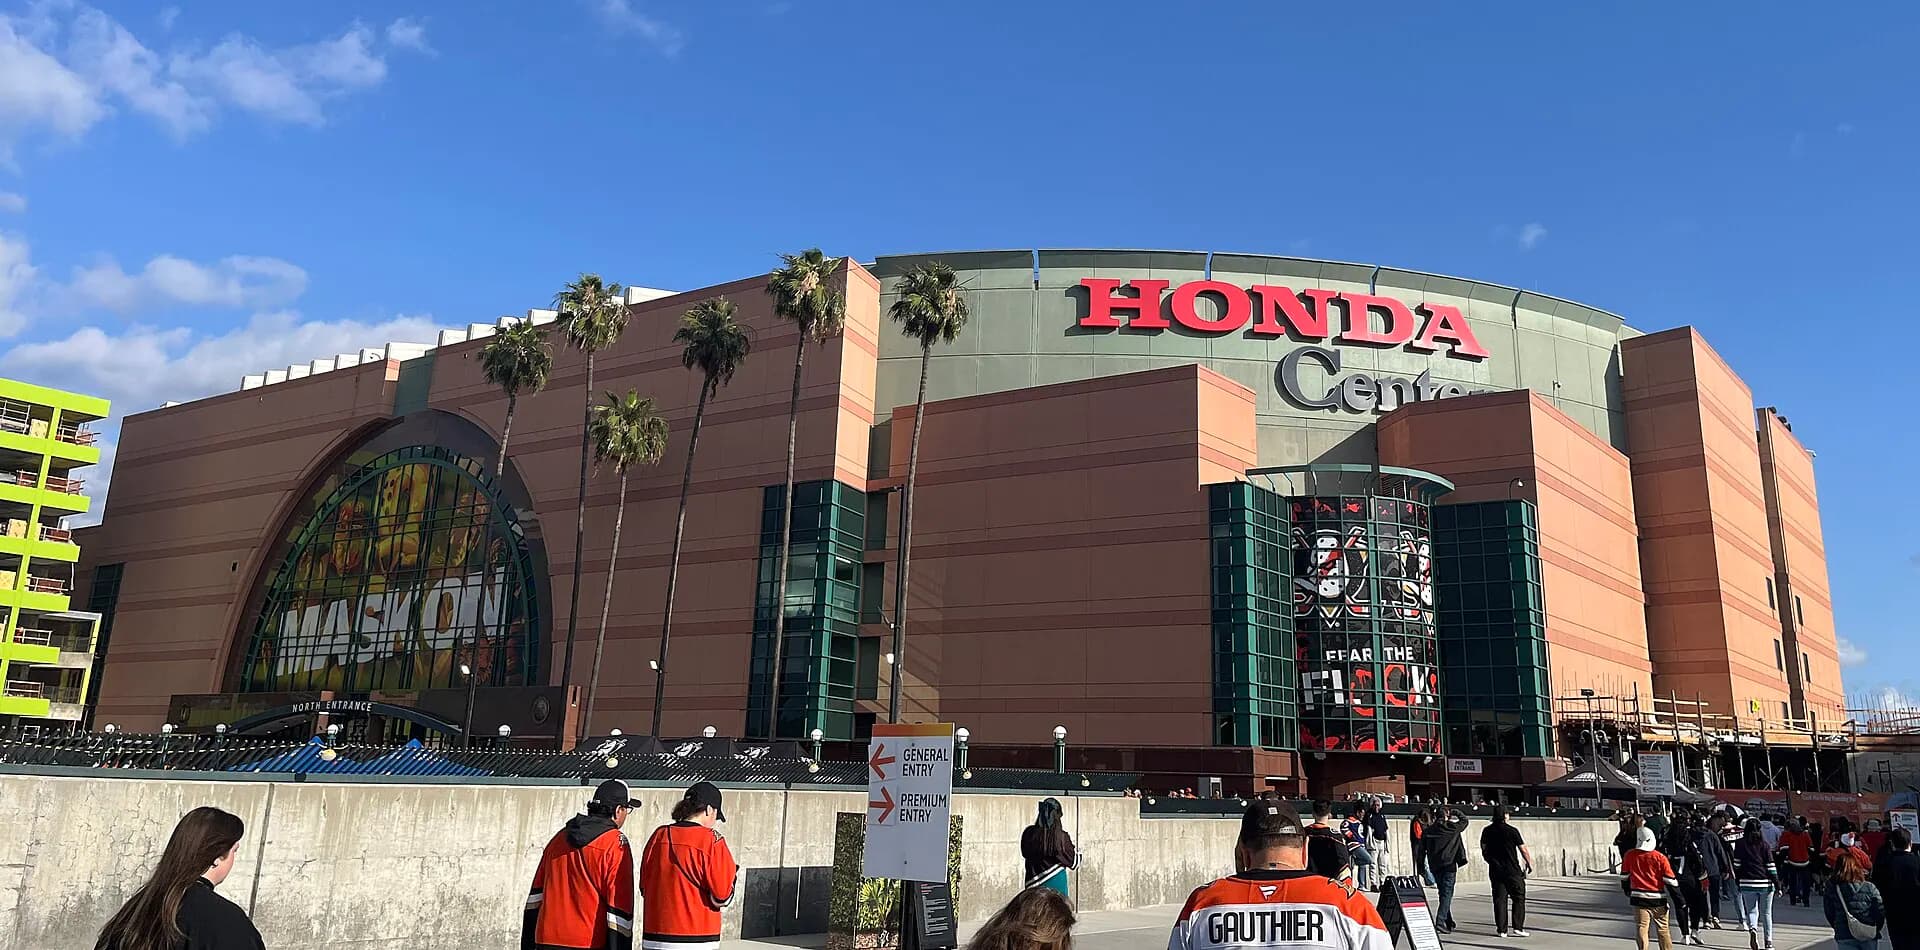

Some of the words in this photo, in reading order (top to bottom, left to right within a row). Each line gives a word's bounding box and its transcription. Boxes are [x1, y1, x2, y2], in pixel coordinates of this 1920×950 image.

[1080, 278, 1490, 358] HONDA
[1278, 346, 1494, 412] Cente
[276, 583, 422, 677] MASK
[422, 566, 509, 650] ON
[1326, 647, 1373, 661] FEAR
[1383, 646, 1414, 661] THE
[292, 701, 321, 713] NORTH
[326, 700, 373, 712] ENTRANCE
[903, 748, 948, 762] GENERAL
[902, 763, 935, 777] ENTRY
[900, 793, 947, 807] PREMIUM
[899, 808, 932, 822] ENTRY
[1208, 909, 1324, 944] GAUTHIER
